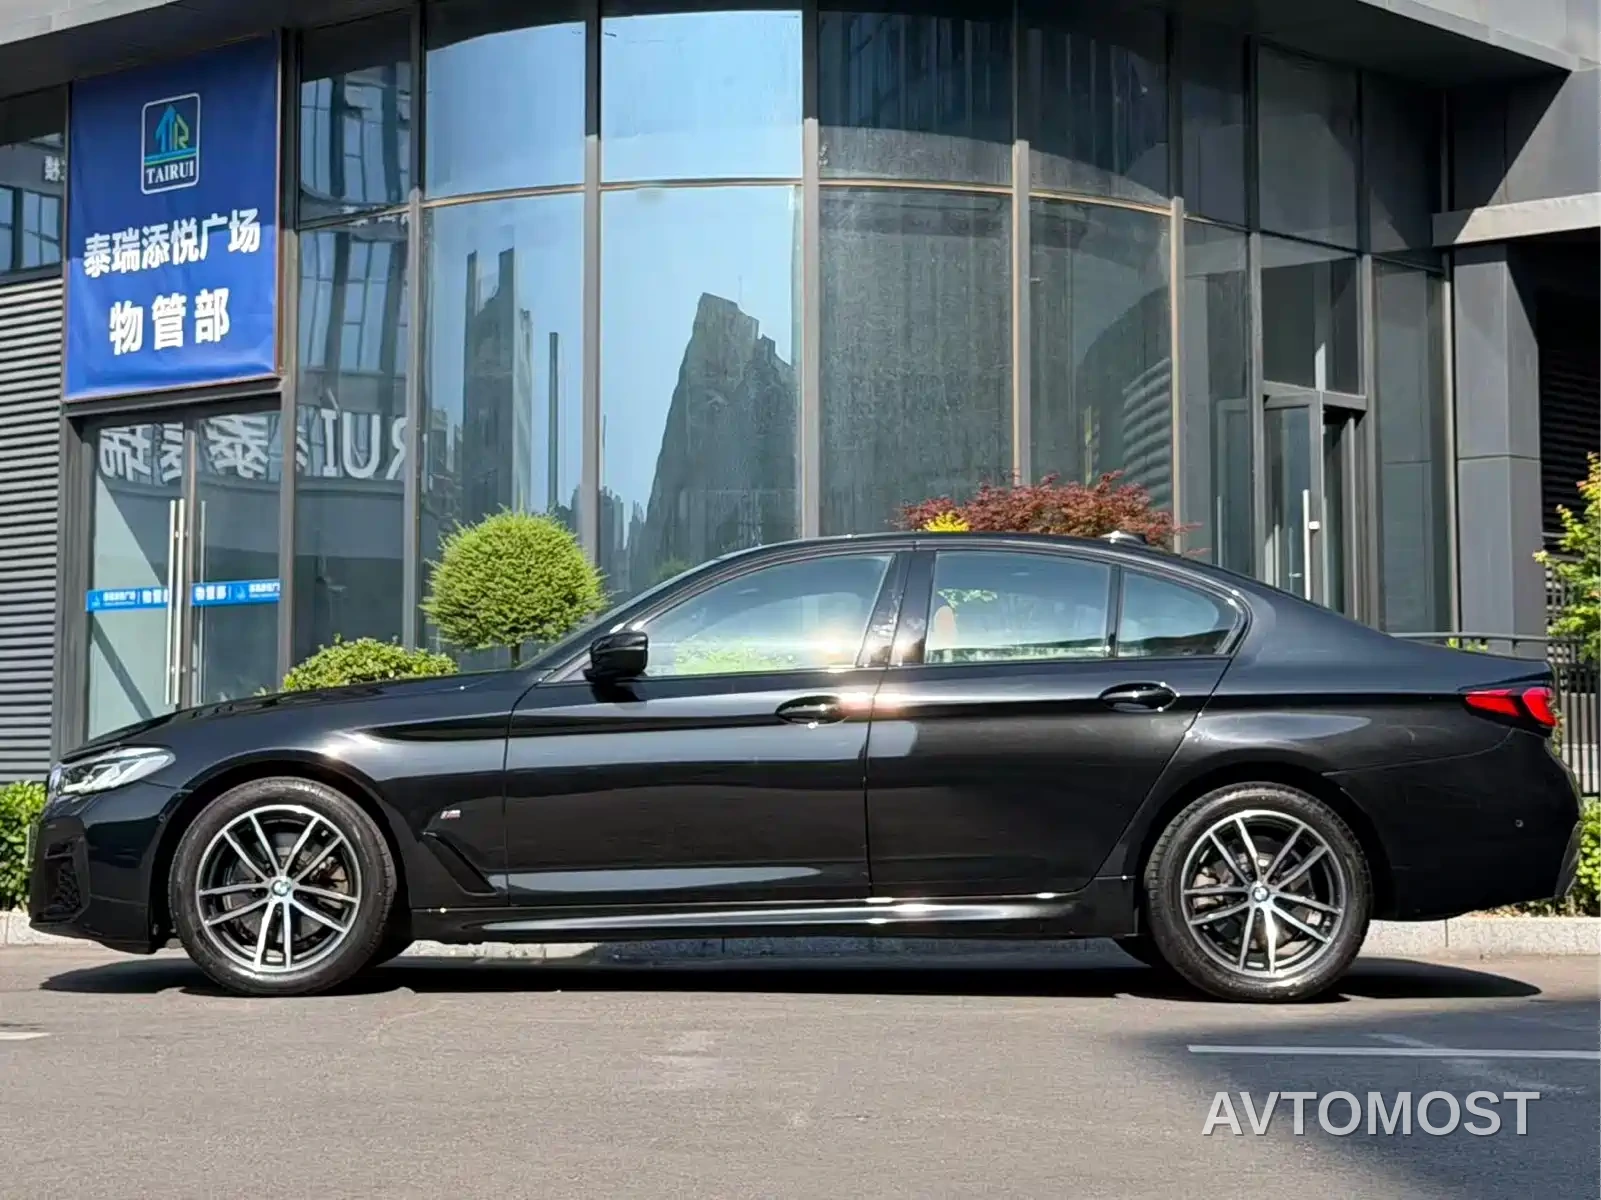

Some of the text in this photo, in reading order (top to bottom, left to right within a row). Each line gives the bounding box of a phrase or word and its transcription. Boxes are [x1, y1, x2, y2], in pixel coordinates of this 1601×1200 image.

[146, 160, 194, 184] TAIRUI
[83, 208, 261, 278] 泰瑞添悦广场
[109, 288, 230, 355] 物管部
